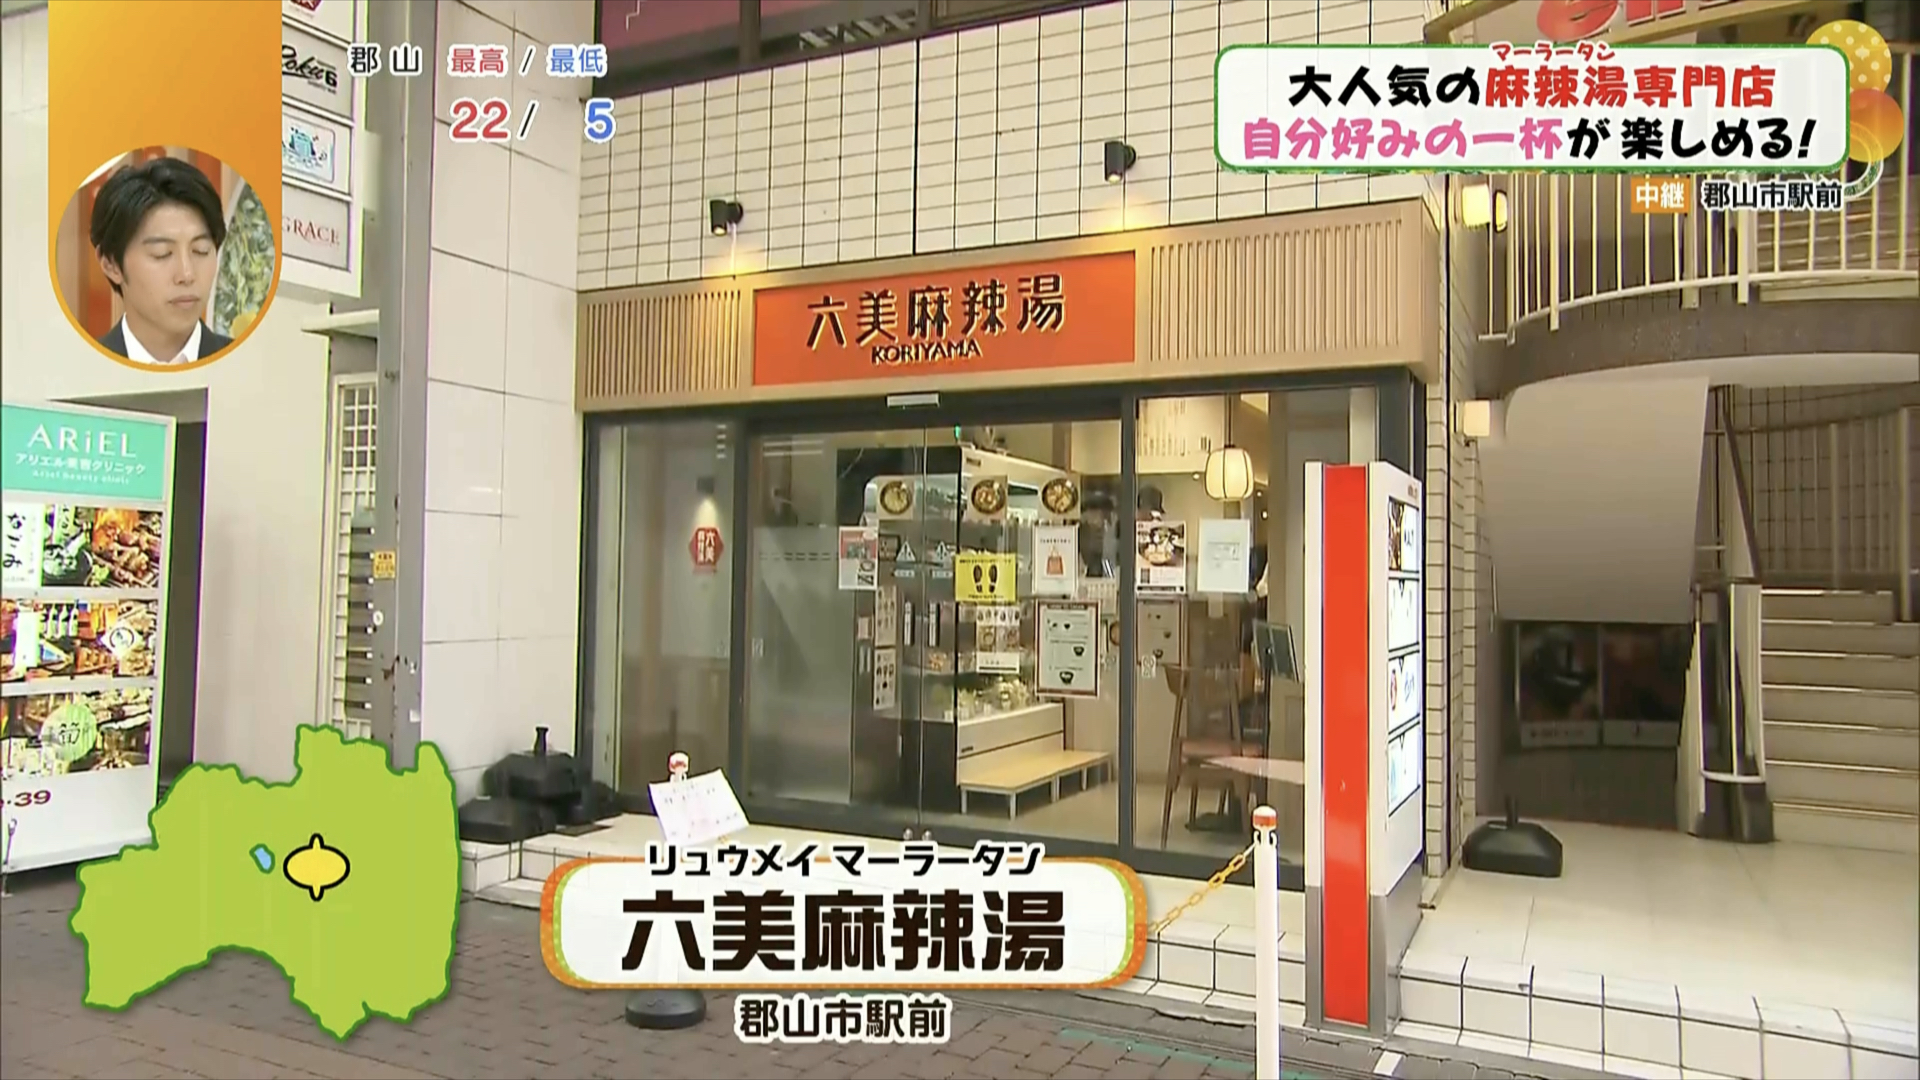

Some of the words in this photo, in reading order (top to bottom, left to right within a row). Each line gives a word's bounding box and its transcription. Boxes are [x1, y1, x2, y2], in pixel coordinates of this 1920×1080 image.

[806, 273, 1066, 350] 六美麻辣湯
[871, 337, 982, 365] KORIYAMA
[27, 424, 137, 459] ARiEL
[16, 453, 146, 475] アリエル美容クリニック
